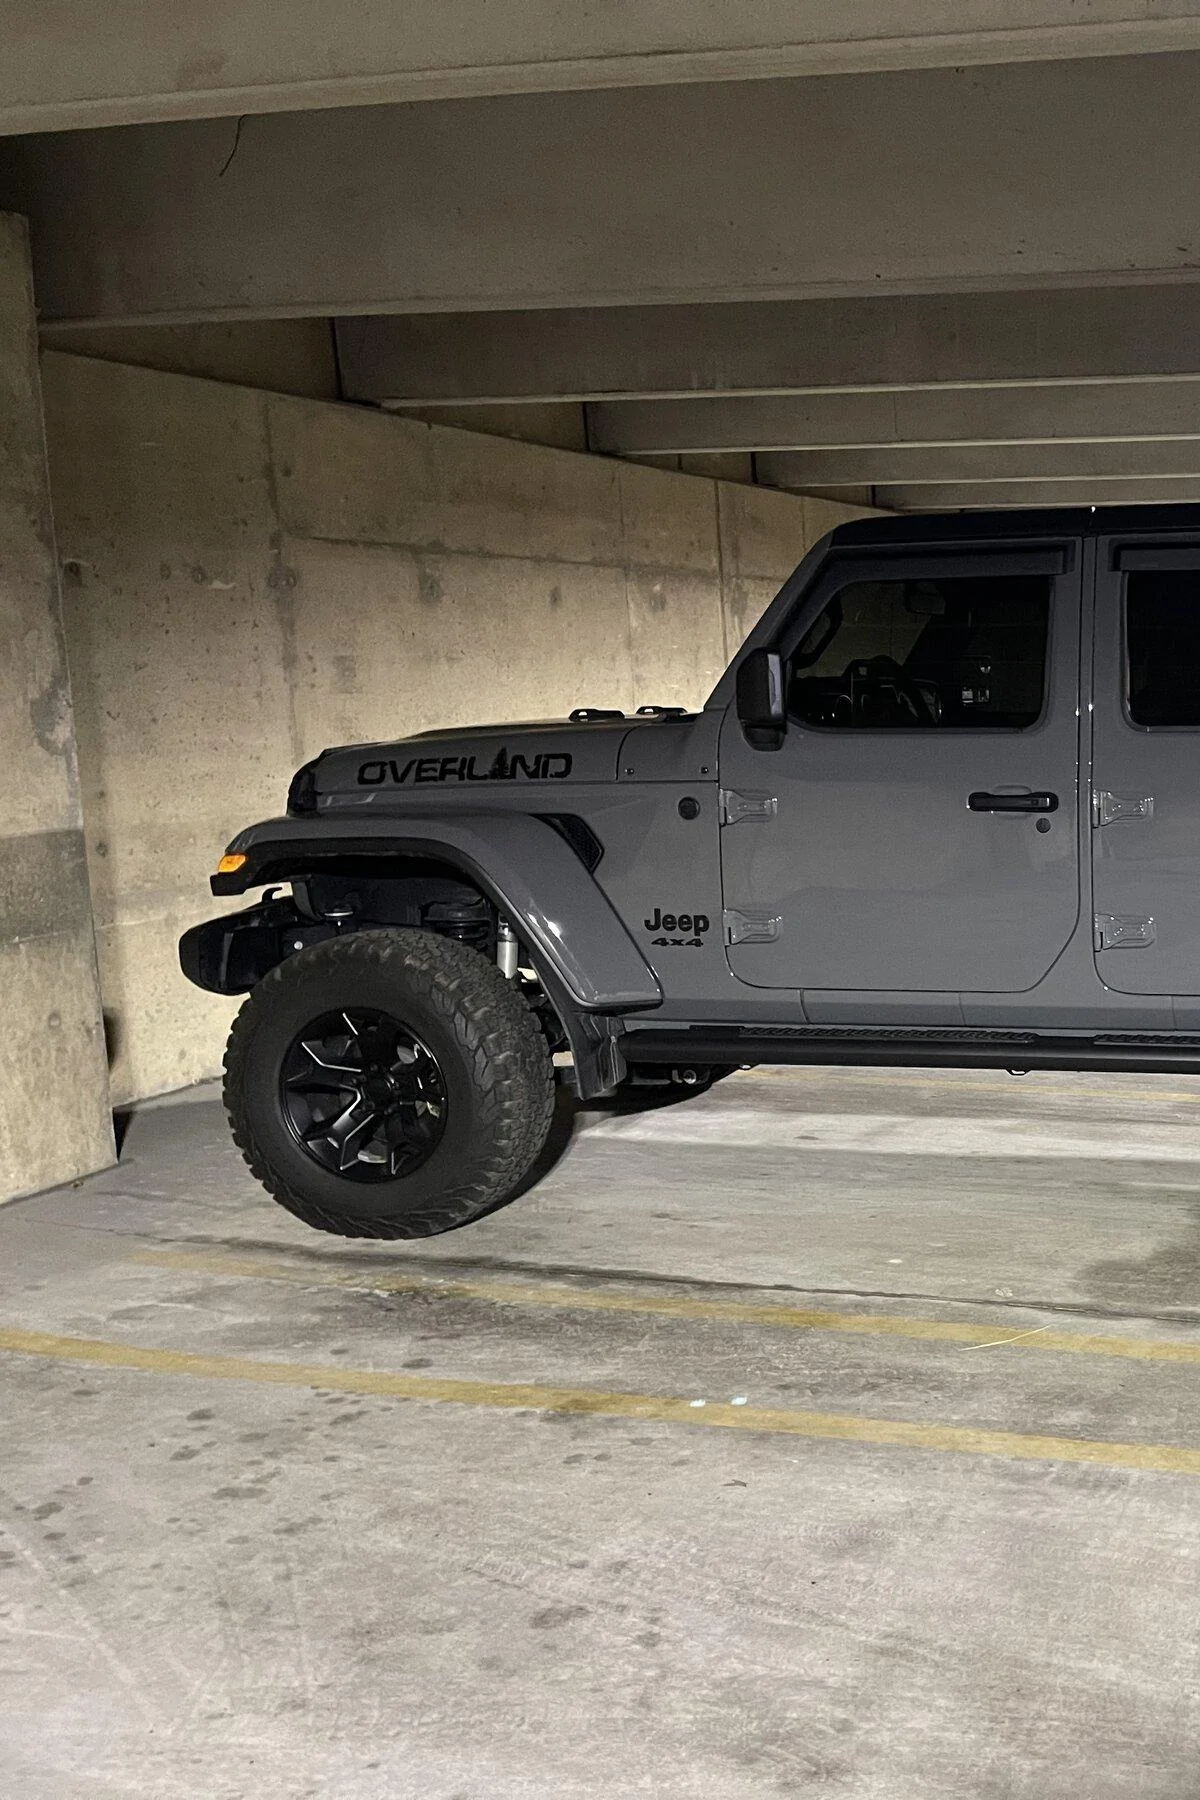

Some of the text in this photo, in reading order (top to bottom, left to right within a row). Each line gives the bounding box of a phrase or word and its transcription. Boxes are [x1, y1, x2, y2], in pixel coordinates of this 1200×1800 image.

[357, 748, 573, 785] OVERLAND
[644, 908, 710, 936] Jeep
[651, 938, 704, 947] 4x4
